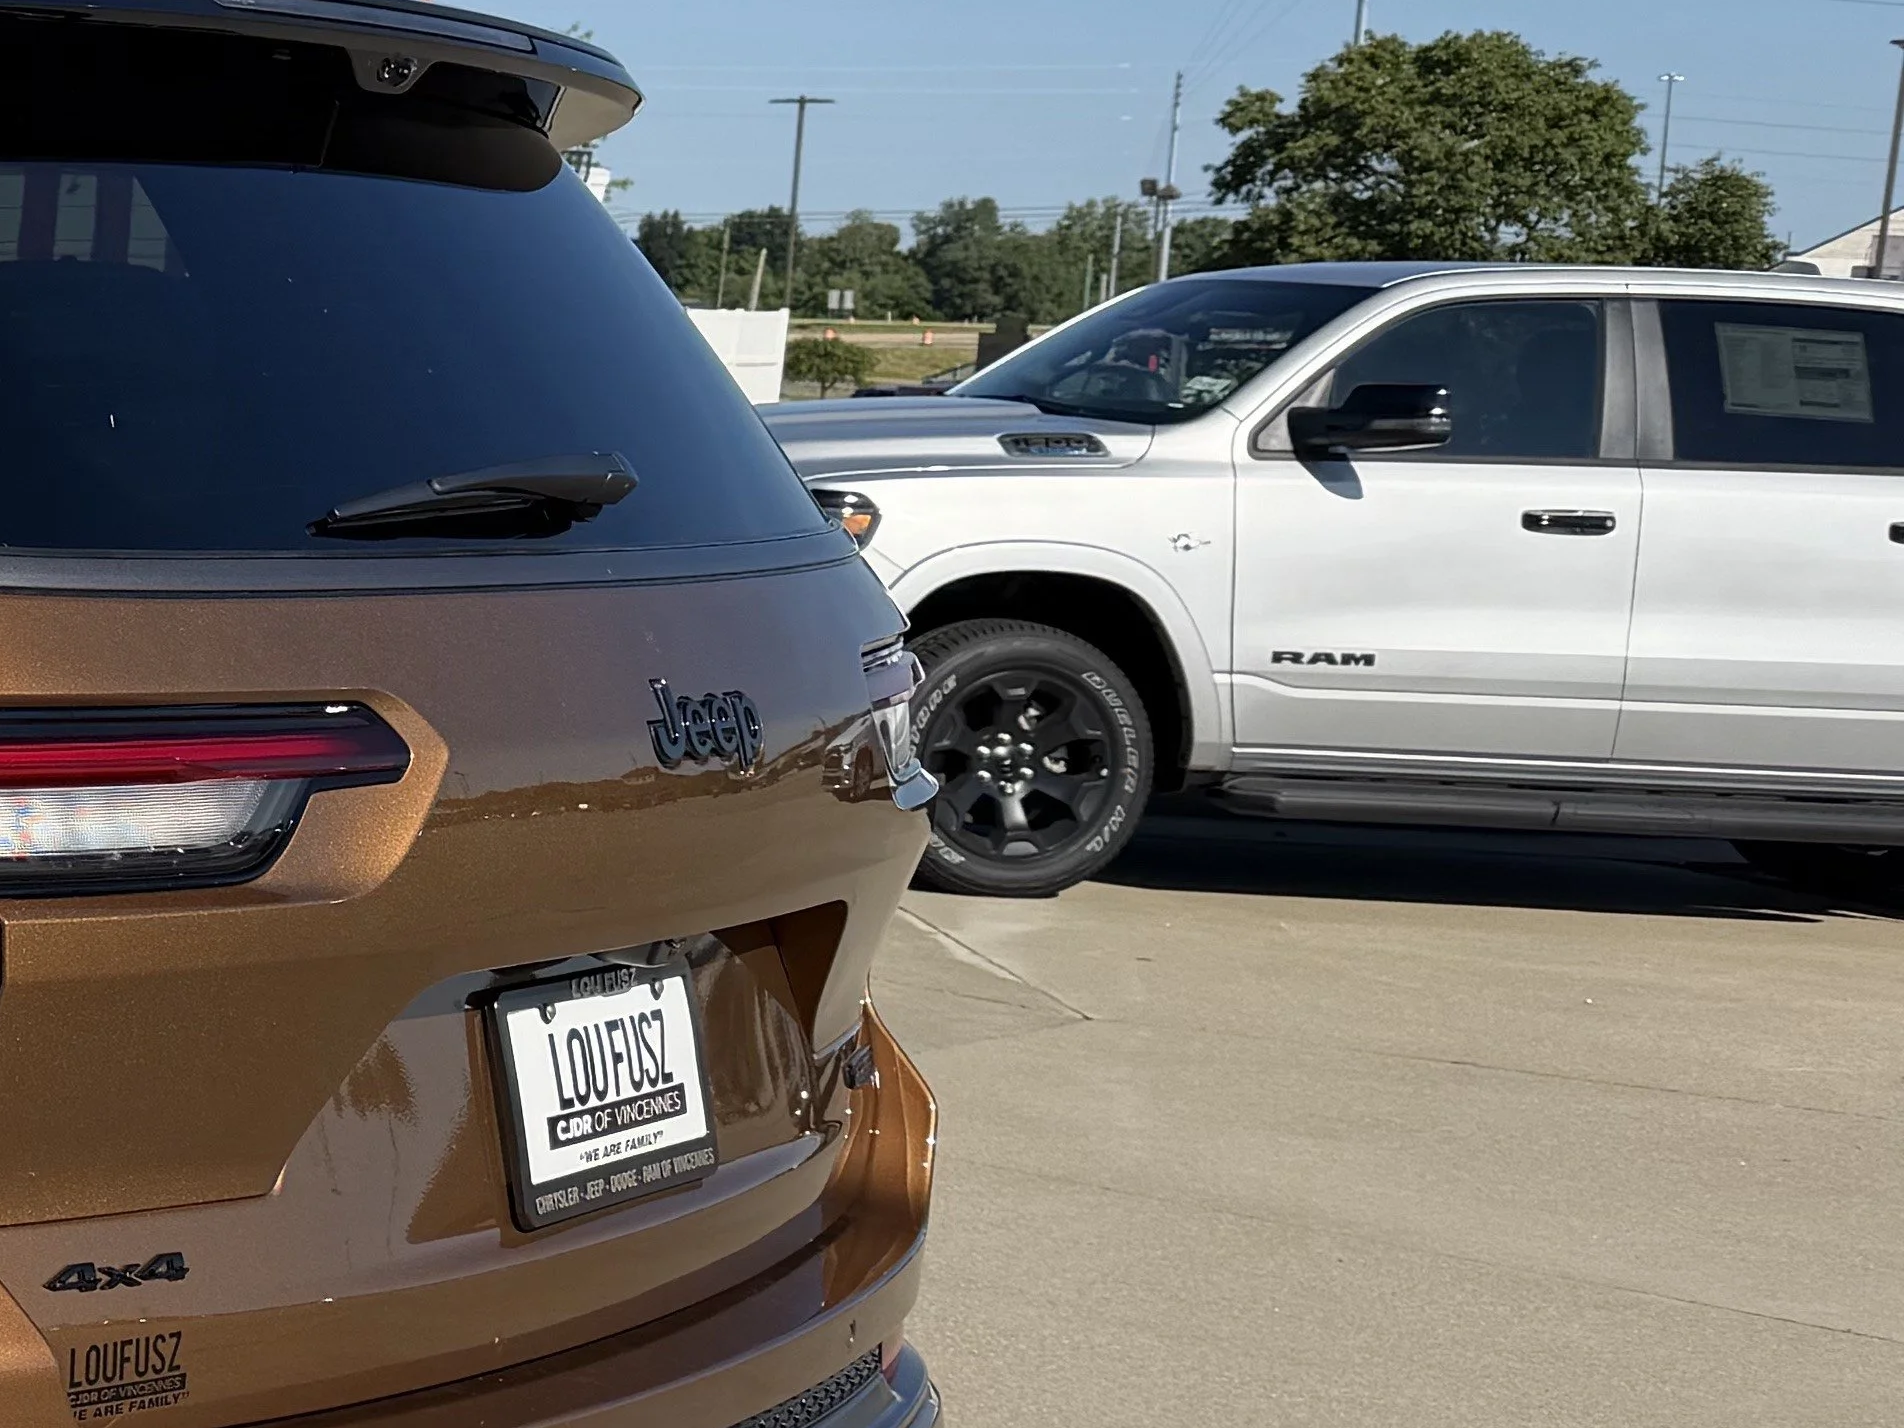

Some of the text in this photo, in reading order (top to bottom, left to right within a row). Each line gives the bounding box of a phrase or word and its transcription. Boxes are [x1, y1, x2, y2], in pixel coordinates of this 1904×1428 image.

[1271, 651, 1376, 666] RAM
[646, 678, 764, 775] Jeep
[556, 1091, 681, 1141] CJDR OF VINCENNES
[602, 1142, 622, 1159] ARE
[535, 1186, 580, 1214] CHRYSLER
[586, 1179, 605, 1200] JEEP
[610, 1169, 639, 1193] DODGE
[642, 1163, 661, 1184] RAM
[661, 1159, 672, 1177] OF
[42, 1252, 190, 1292] 4x4
[68, 1392, 99, 1406] CJDR
[100, 1388, 118, 1401] OF
[93, 1403, 124, 1418] ARE
